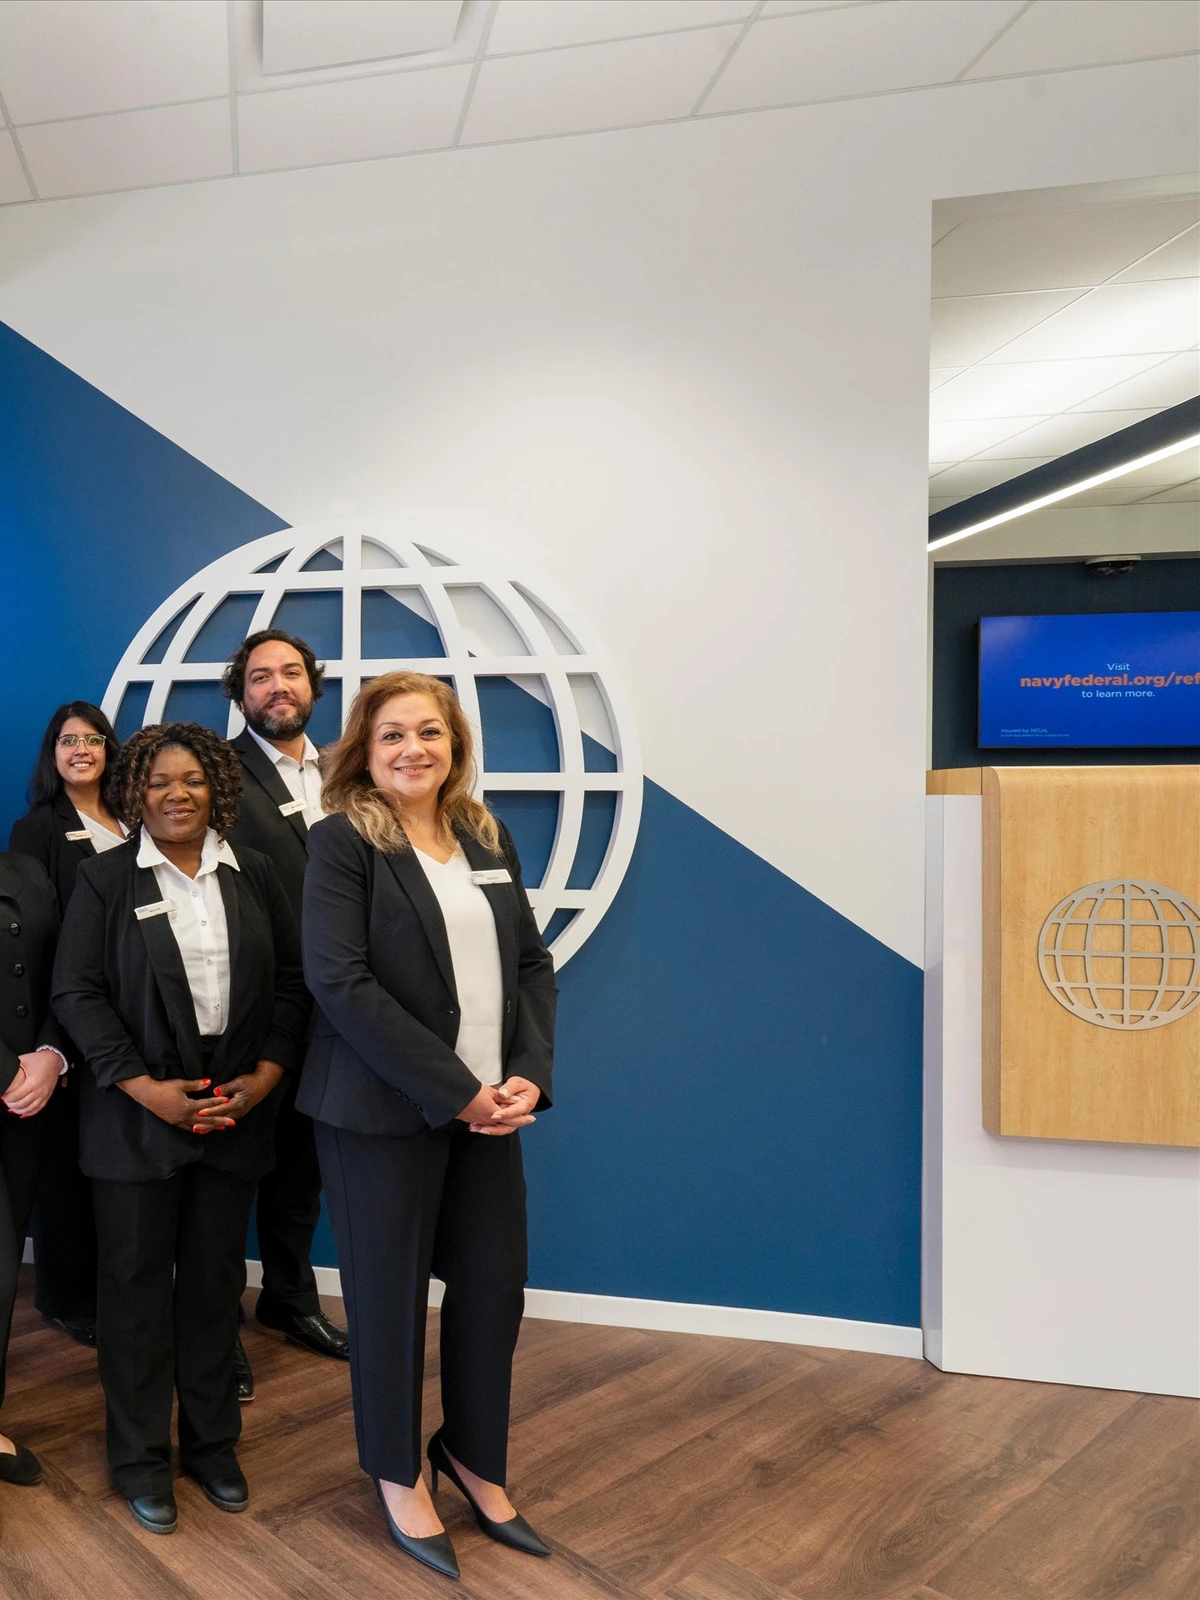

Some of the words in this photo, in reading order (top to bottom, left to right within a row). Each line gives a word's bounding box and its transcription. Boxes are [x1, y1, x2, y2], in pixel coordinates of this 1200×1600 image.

[1107, 663, 1130, 671] Visit
[1081, 690, 1093, 698] to
[1096, 690, 1122, 698] learn
[1125, 690, 1156, 698] more.
